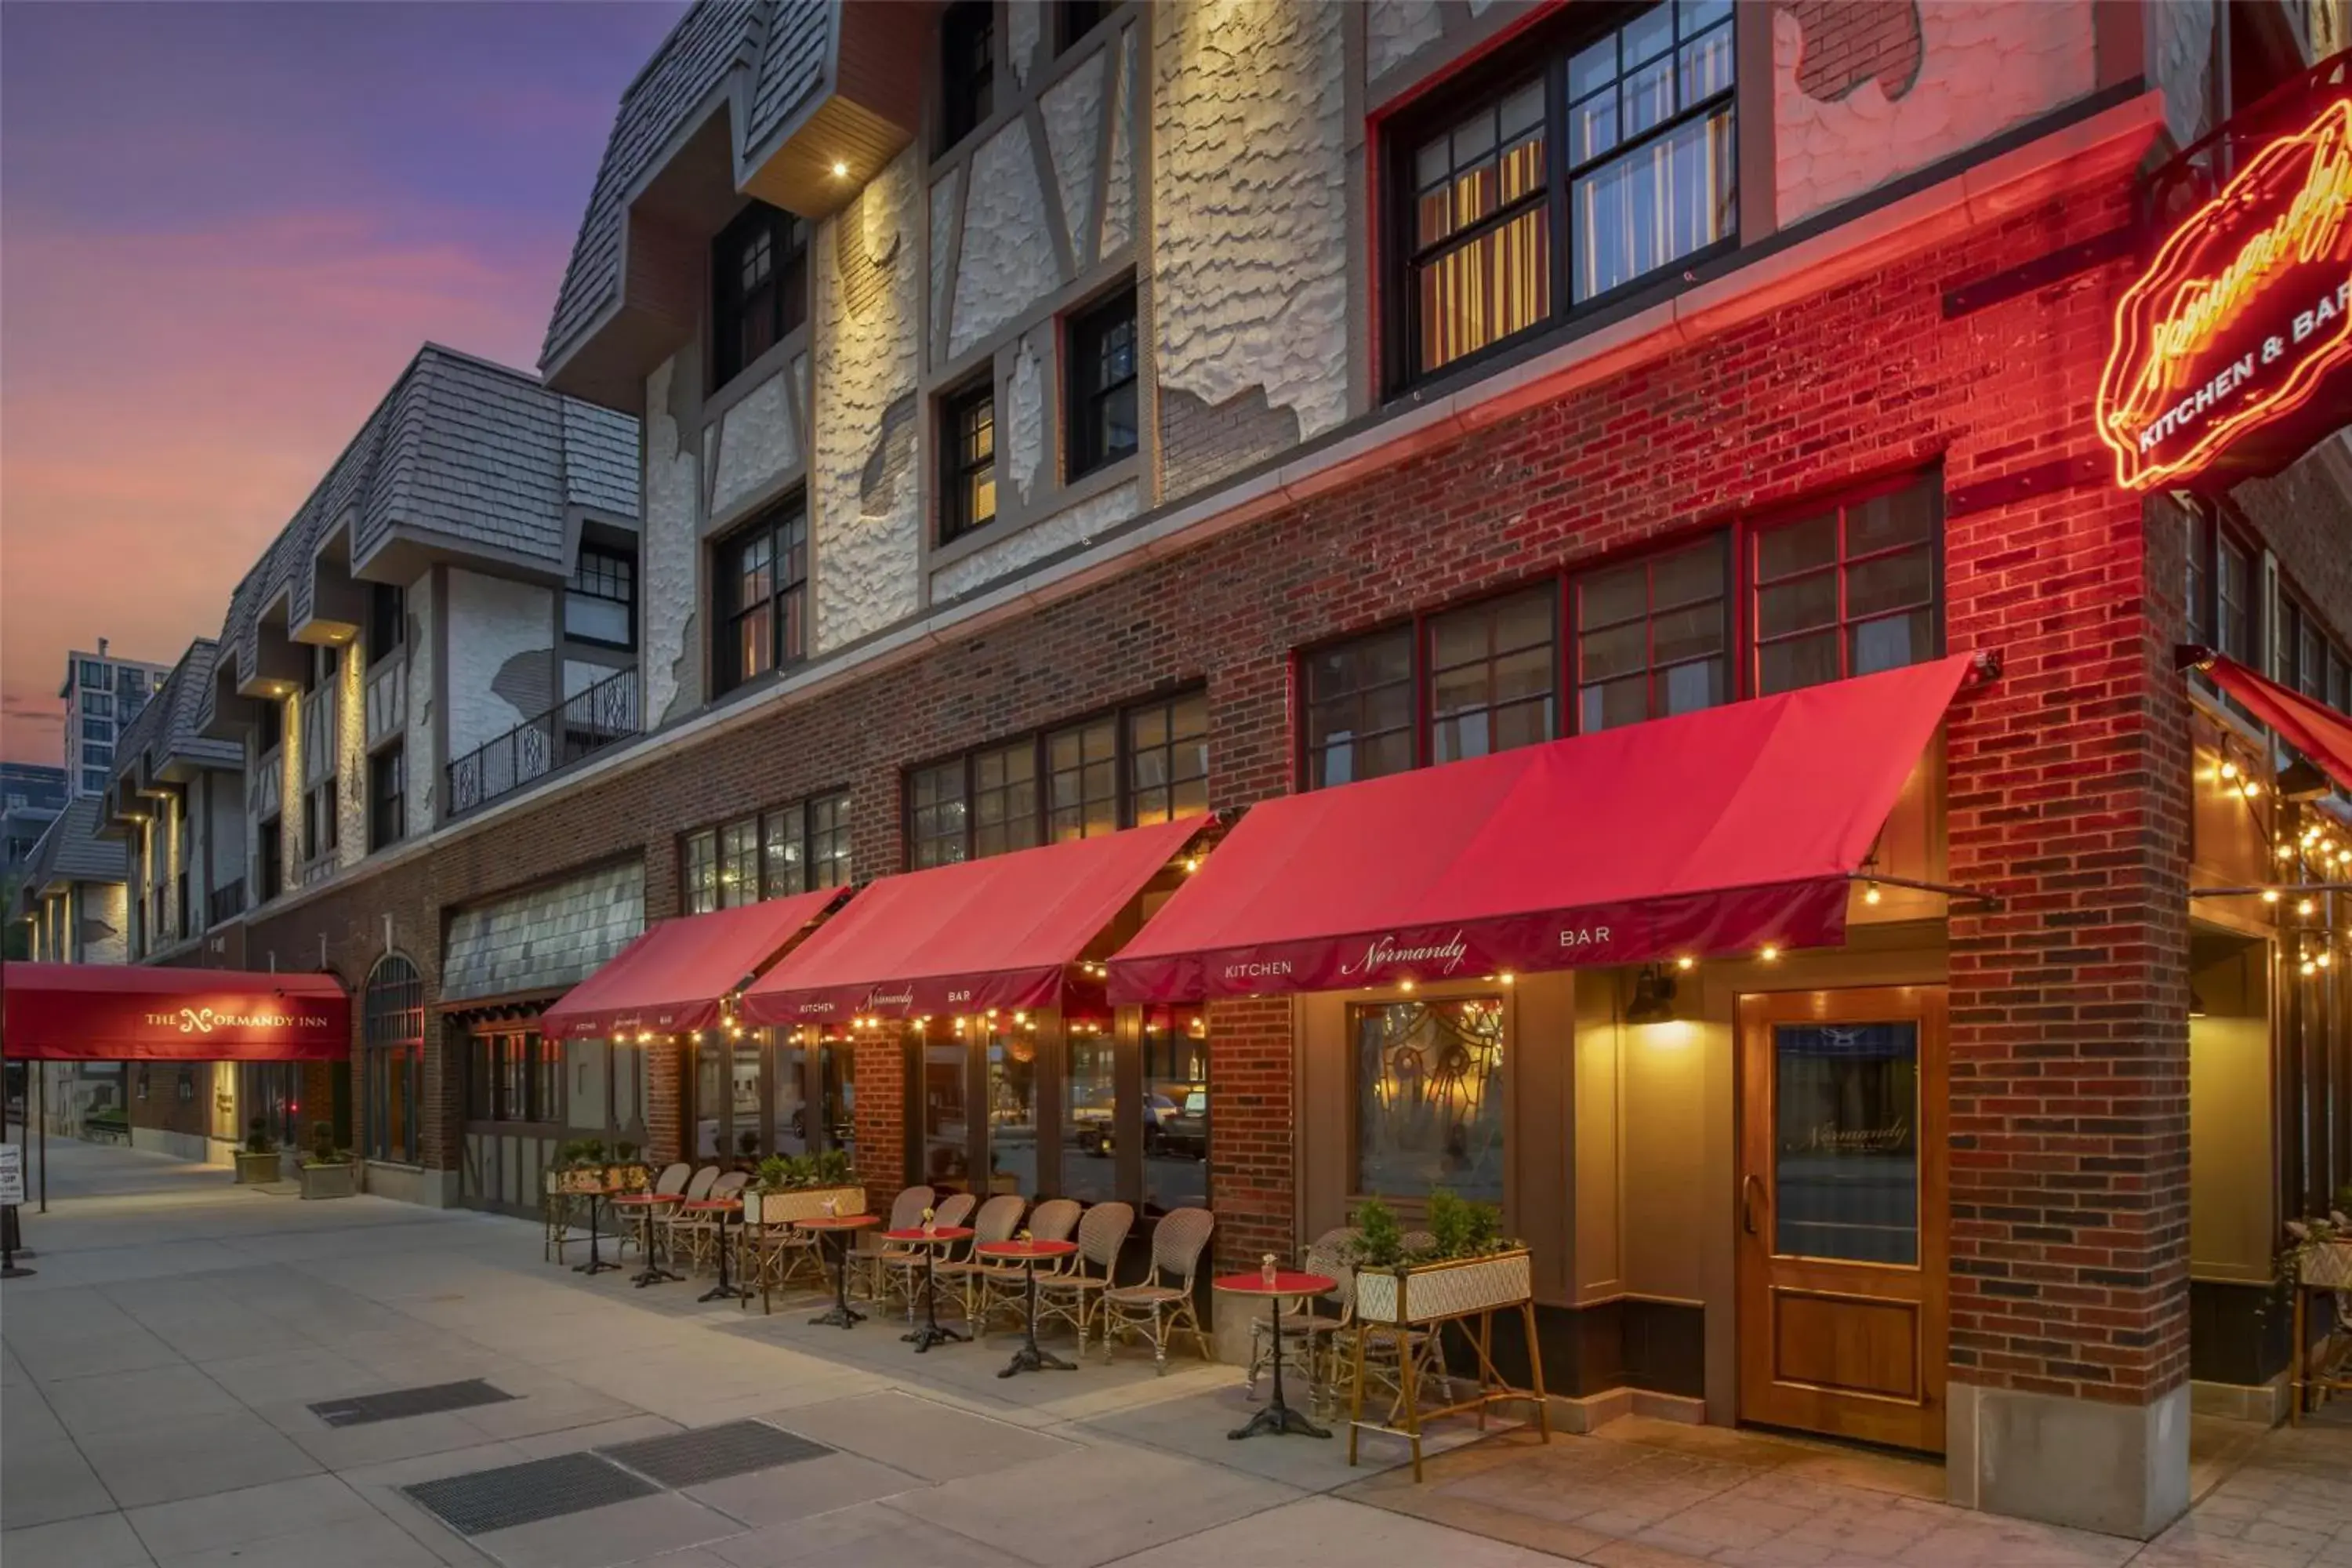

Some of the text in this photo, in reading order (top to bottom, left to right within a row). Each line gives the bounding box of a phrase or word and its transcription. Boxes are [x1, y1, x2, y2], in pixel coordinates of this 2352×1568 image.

[2139, 352, 2255, 453] KITCHEN
[2261, 336, 2285, 365] &
[1225, 926, 1610, 978] KITCHEN Normandy BAR
[145, 1007, 328, 1033] THE NORMANDY INN
[799, 1003, 836, 1014] KITCHEN
[948, 990, 971, 1003] BAR
